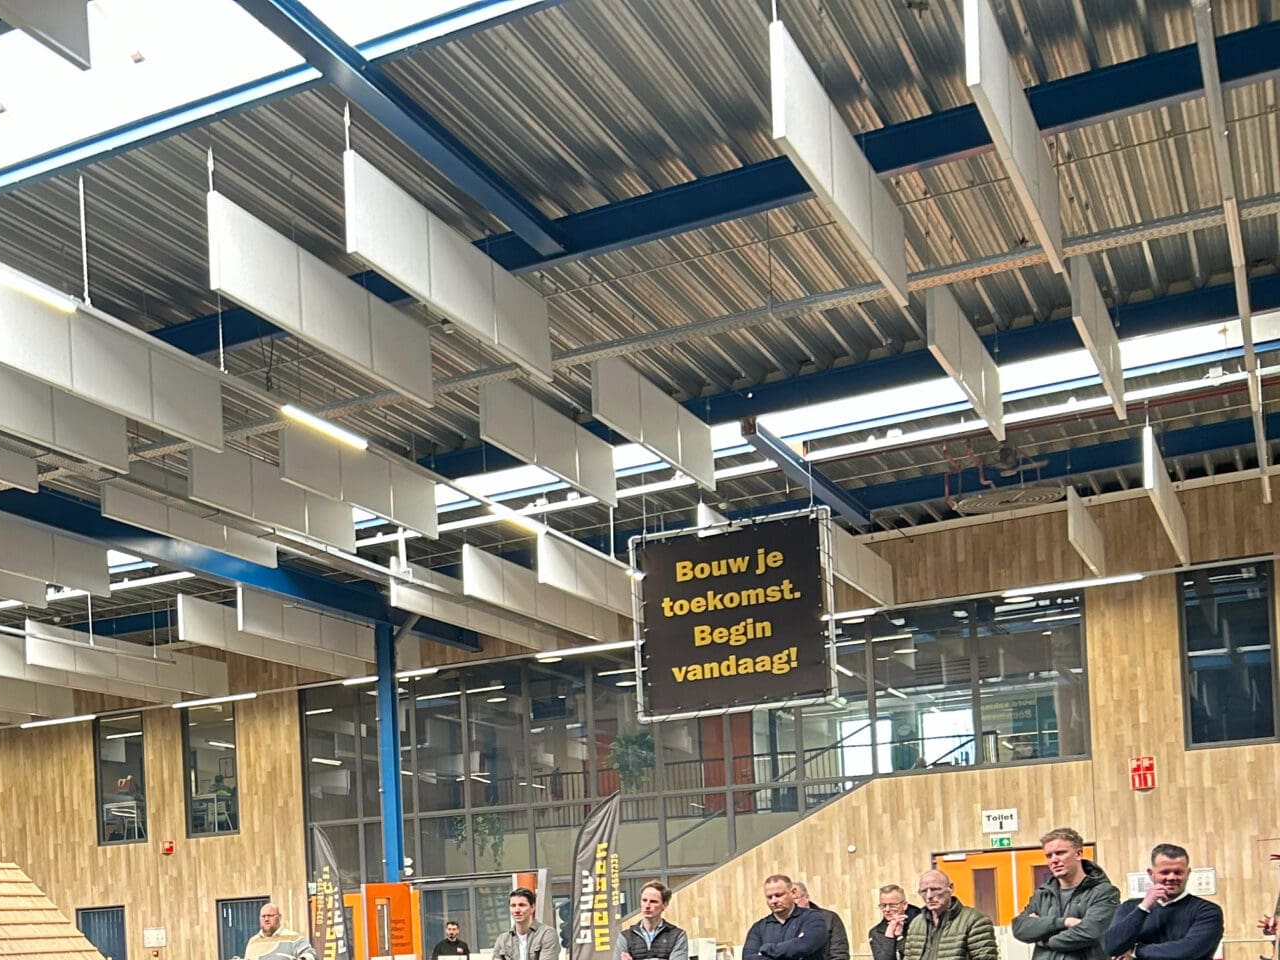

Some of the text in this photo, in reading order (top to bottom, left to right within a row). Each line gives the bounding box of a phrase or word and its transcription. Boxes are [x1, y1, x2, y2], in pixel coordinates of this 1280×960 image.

[675, 548, 784, 582] Bouw je
[661, 579, 801, 617] toekomst.
[694, 618, 772, 647] Begin
[672, 647, 799, 682] vandaag!
[985, 813, 1014, 822] Toilet
[592, 842, 611, 952] mensen
